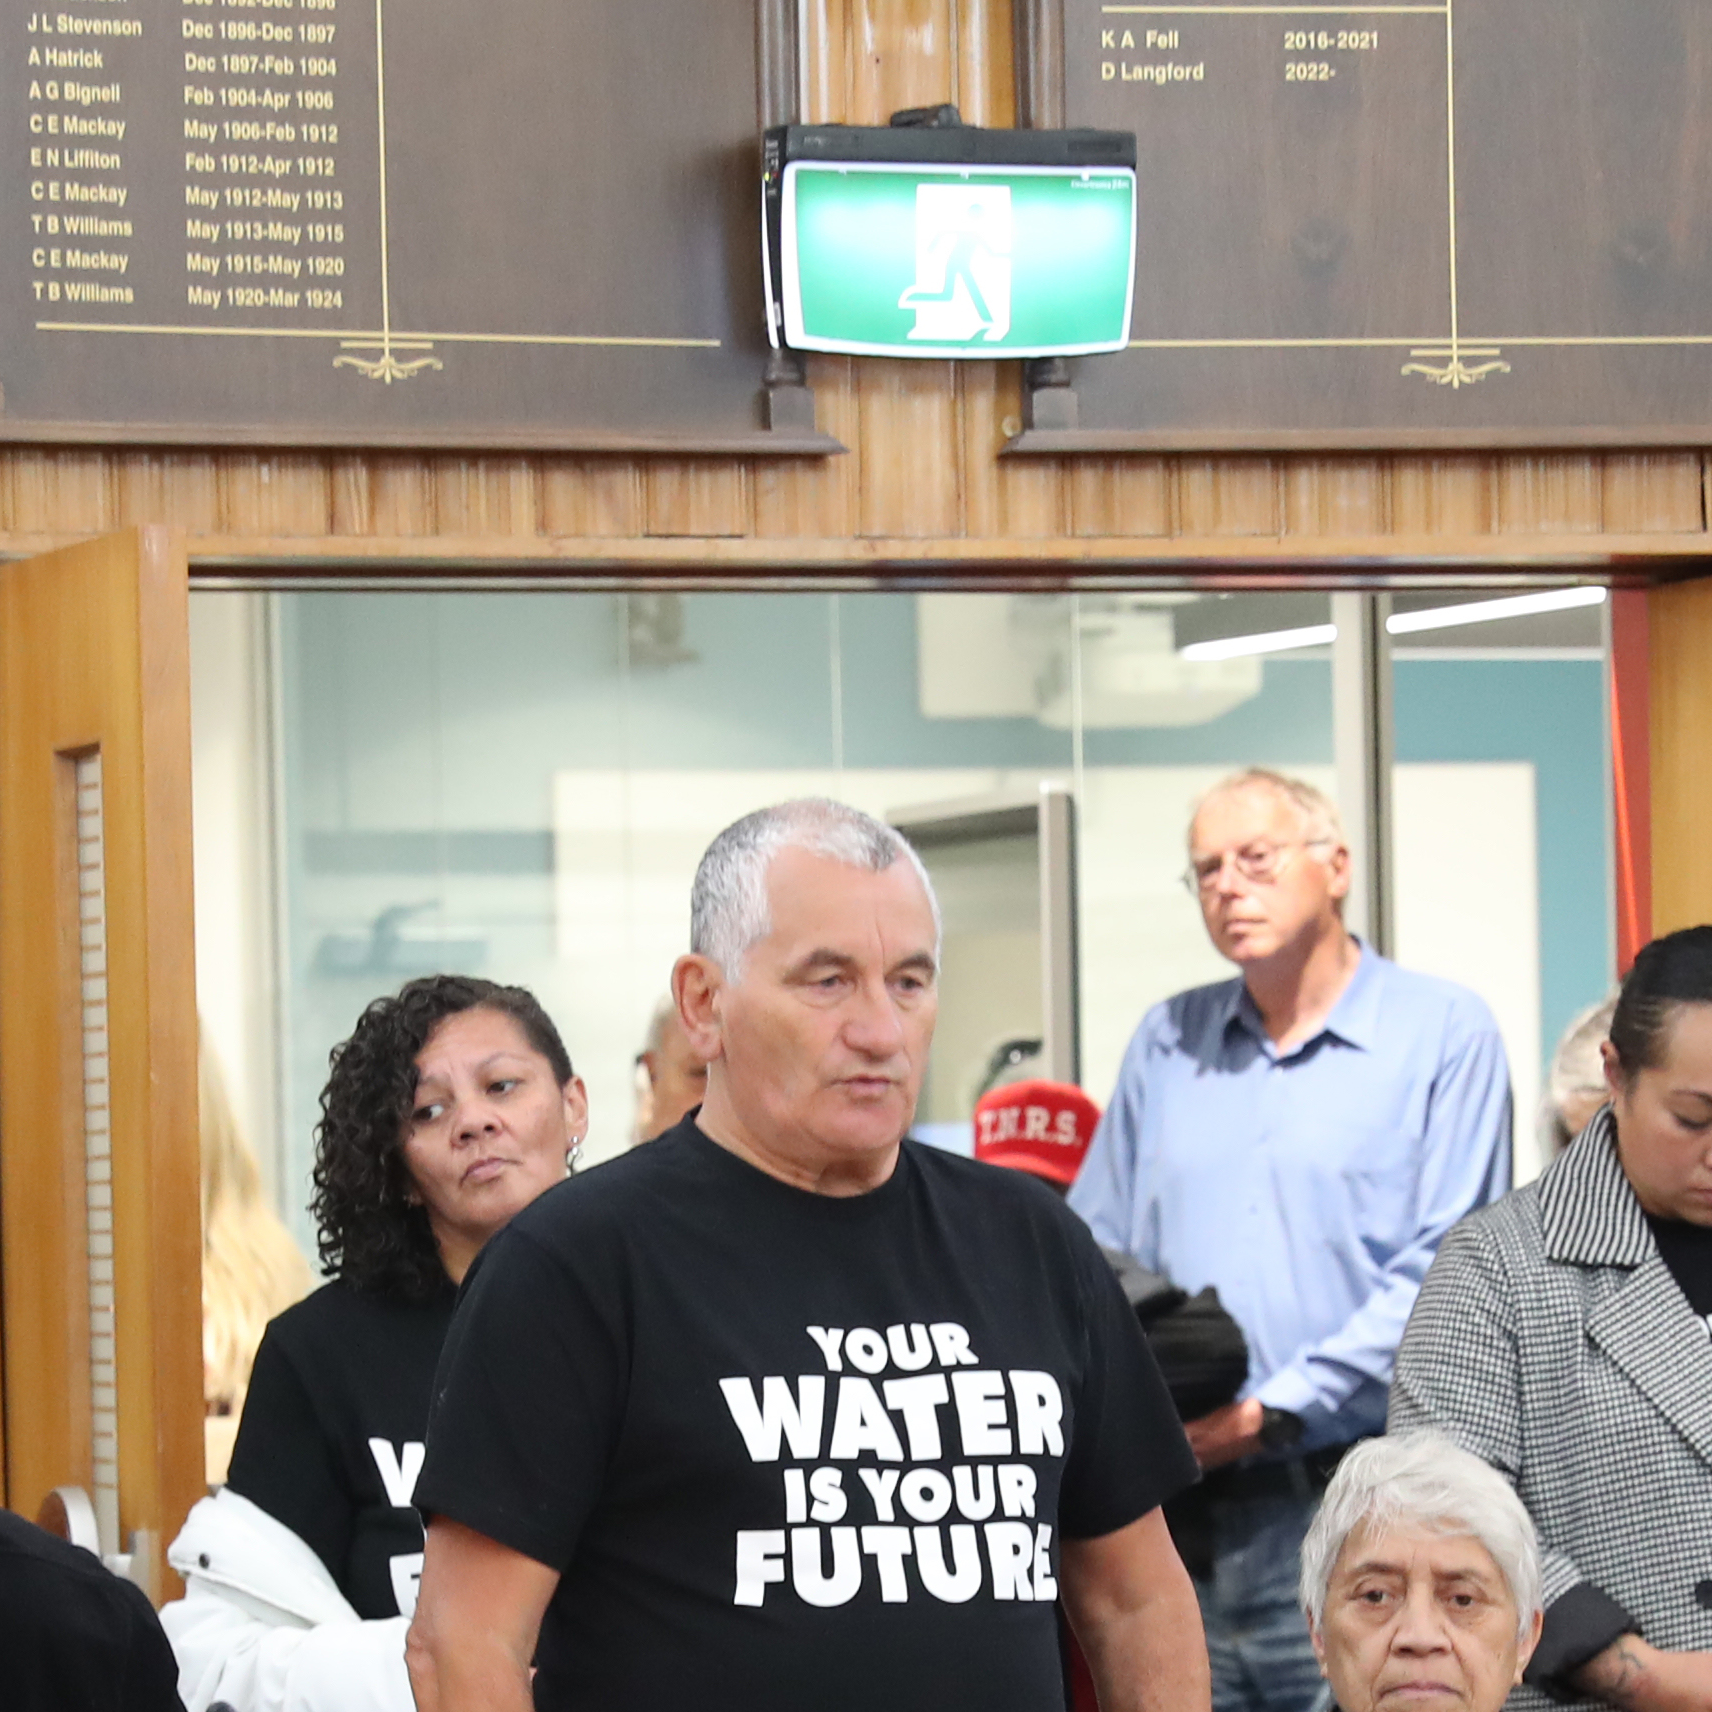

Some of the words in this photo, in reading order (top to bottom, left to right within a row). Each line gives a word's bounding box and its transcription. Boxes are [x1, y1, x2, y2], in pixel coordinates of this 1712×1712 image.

[28, 13, 37, 32] J
[42, 14, 52, 33] L
[57, 14, 142, 35] Stevenson
[183, 19, 213, 38] Dec
[220, 21, 293, 41] 1896-Dec
[299, 24, 335, 43] 1897
[1102, 30, 1116, 49] K
[1121, 30, 1135, 49] A
[1147, 30, 1179, 49] Fell
[29, 46, 40, 66] A
[46, 47, 103, 68] Hatrick
[185, 53, 215, 72] Dec
[222, 55, 294, 75] 1897-Feb
[300, 57, 337, 76] 1904
[1102, 62, 1115, 81] D
[1122, 62, 1204, 85] Langford
[1286, 63, 1336, 81] 2022-
[29, 80, 41, 100] A
[46, 81, 59, 100] G
[64, 82, 120, 105] Bignell
[184, 86, 214, 105] Feb
[220, 88, 291, 112] 1904-Apr
[297, 90, 333, 109] 1906
[30, 114, 42, 133] C
[48, 115, 58, 133] E
[64, 116, 126, 140] Mackay
[184, 119, 217, 142] May
[224, 121, 295, 141] 1906-Feb
[302, 124, 338, 143] 1912
[31, 148, 41, 166] E
[47, 148, 59, 167] N
[186, 152, 215, 171] Feb
[221, 154, 292, 178] 1912-Apr
[298, 157, 334, 176] 1912
[31, 181, 43, 200] C
[49, 182, 60, 200] E
[65, 182, 127, 206] Mackay
[186, 186, 219, 209] May
[225, 188, 300, 212] 1912-May
[306, 190, 343, 209] 1913
[32, 214, 42, 234] T
[47, 215, 59, 234] B
[64, 216, 133, 237] Williams
[187, 219, 220, 242] May
[226, 221, 301, 245] 1913-May
[307, 223, 344, 242] 1915
[33, 248, 45, 267] C
[51, 249, 61, 267] E
[66, 250, 128, 273] Mackay
[187, 253, 220, 276] May
[226, 254, 302, 278] 1915-May
[308, 257, 344, 276] 1920
[33, 281, 43, 301] T
[49, 282, 60, 301] B
[65, 283, 134, 303] Williams
[188, 286, 221, 309] May
[228, 288, 300, 307] 1920-Mar
[306, 290, 343, 308] 1924
[806, 1322, 979, 1374] YOUR
[718, 1369, 1064, 1462] WATER
[783, 1466, 848, 1524] IS
[858, 1463, 1037, 1524] YOUR
[733, 1521, 1058, 1608] FUTURE
